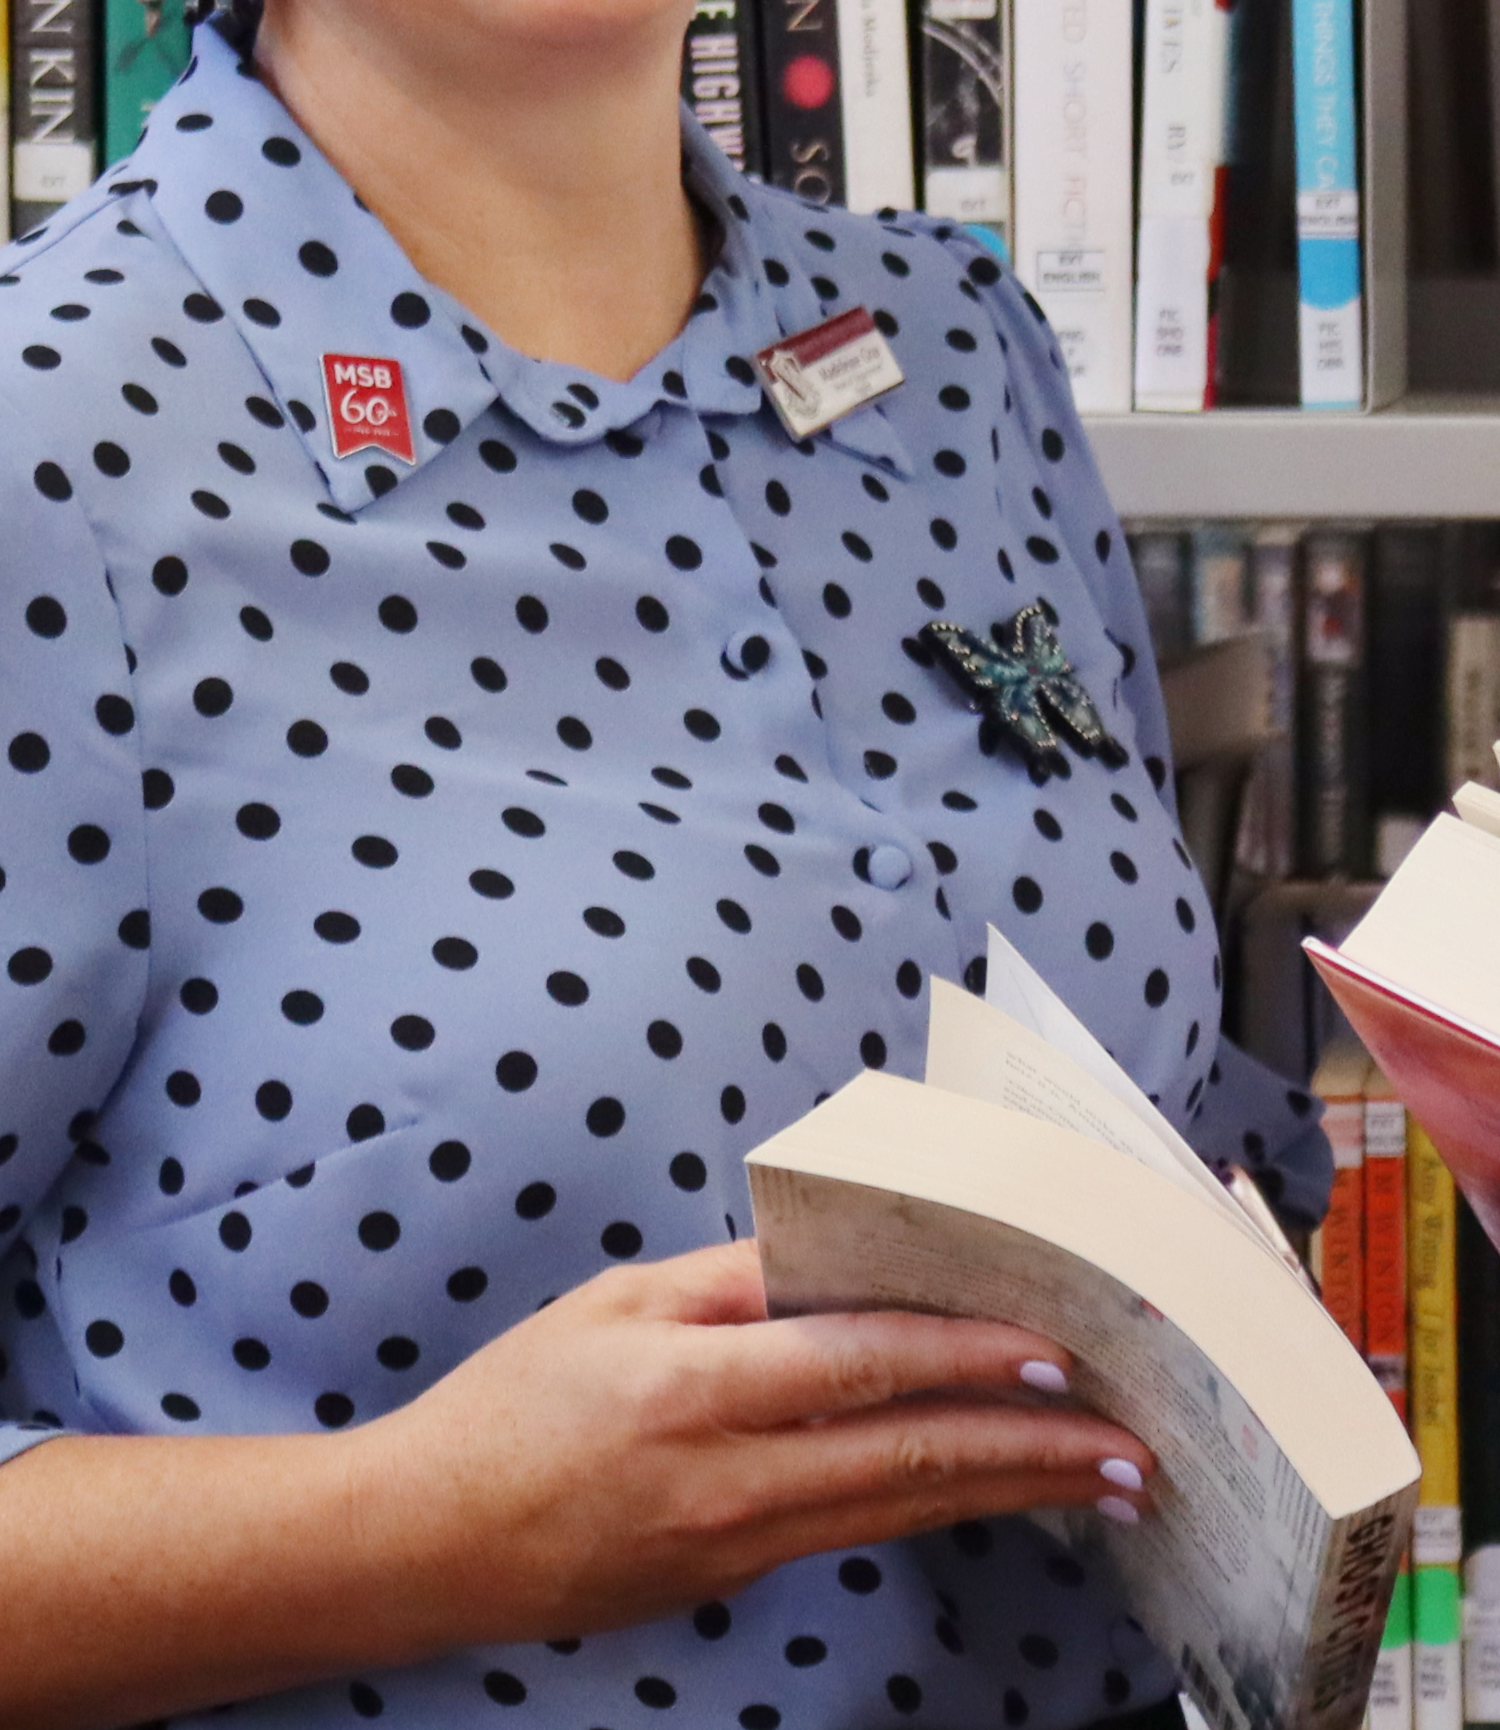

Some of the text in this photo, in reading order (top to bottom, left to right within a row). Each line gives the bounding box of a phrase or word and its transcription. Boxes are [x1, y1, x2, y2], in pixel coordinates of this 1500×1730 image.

[27, 47, 78, 146] KIN
[1062, 60, 1088, 154] SHORT
[1316, 91, 1340, 148] THEY
[333, 362, 393, 389] MSB
[340, 389, 390, 427] 60
